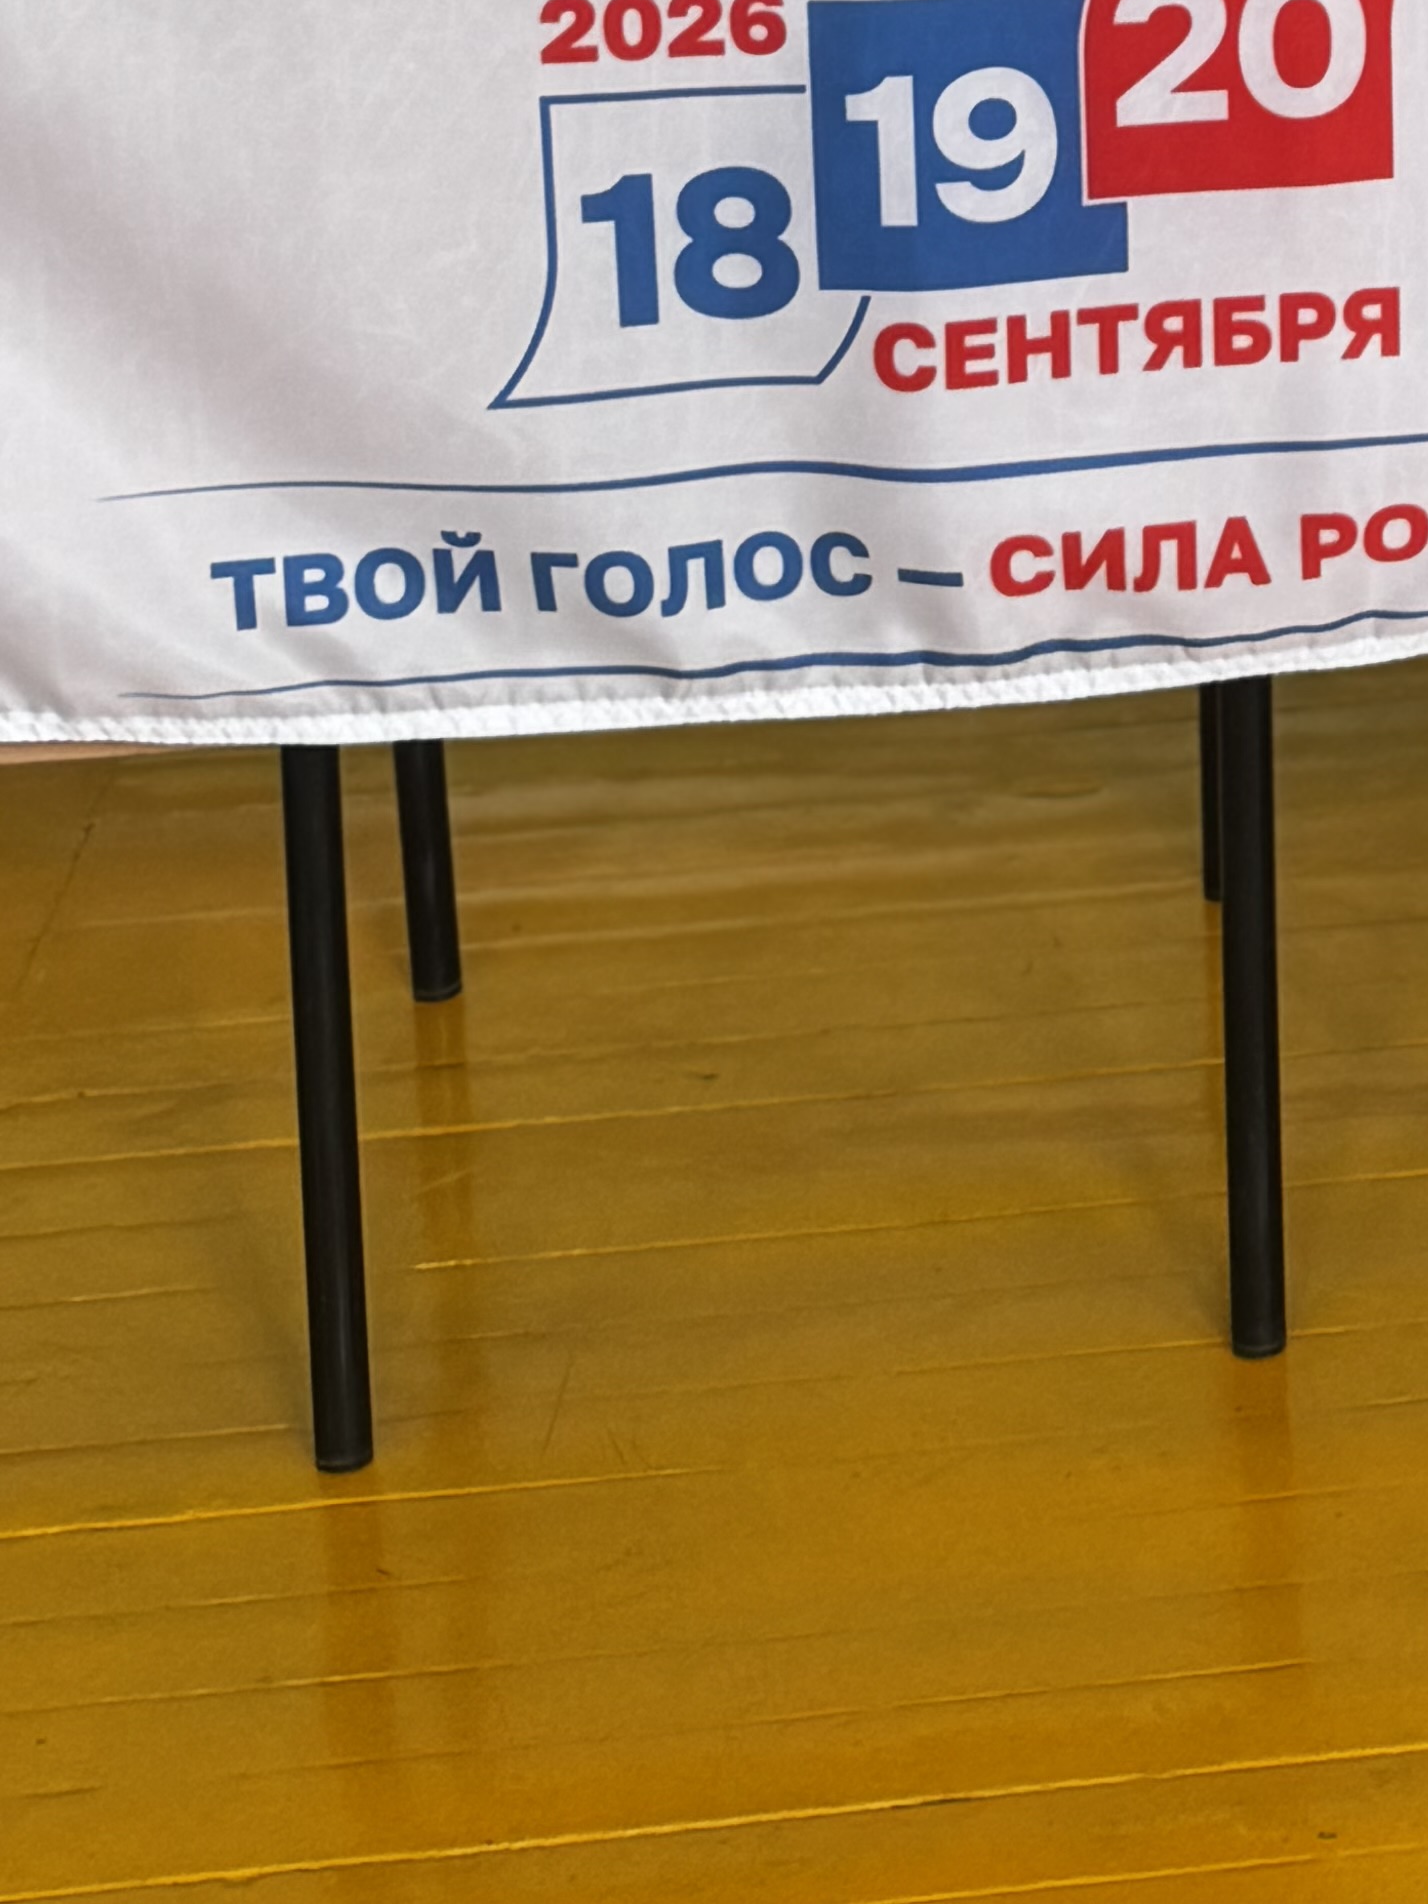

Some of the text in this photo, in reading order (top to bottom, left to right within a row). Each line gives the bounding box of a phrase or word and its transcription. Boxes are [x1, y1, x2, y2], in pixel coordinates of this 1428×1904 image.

[580, 166, 802, 328] 18
[844, 65, 1058, 228] 19
[872, 286, 1401, 393] СЕНТЯБРЯ
[210, 529, 502, 631] ТВОЙ
[530, 531, 872, 617] ГОЛОС
[988, 516, 1271, 597] СИЛА
